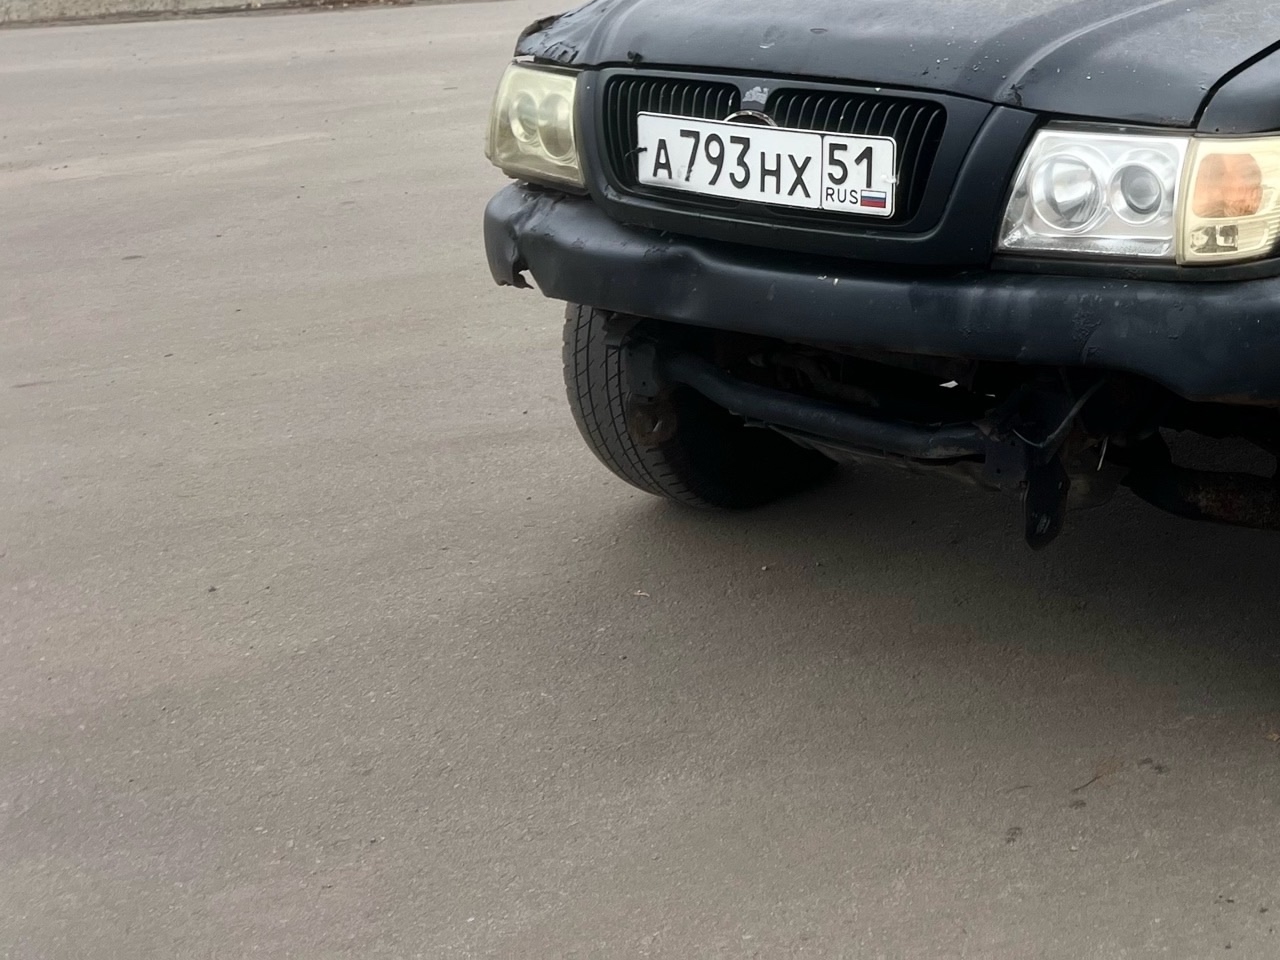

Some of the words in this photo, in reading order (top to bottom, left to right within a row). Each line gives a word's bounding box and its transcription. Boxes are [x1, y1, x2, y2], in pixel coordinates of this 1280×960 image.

[653, 129, 811, 198] А793НХ
[828, 143, 873, 188] 51
[825, 187, 858, 204] RUS
